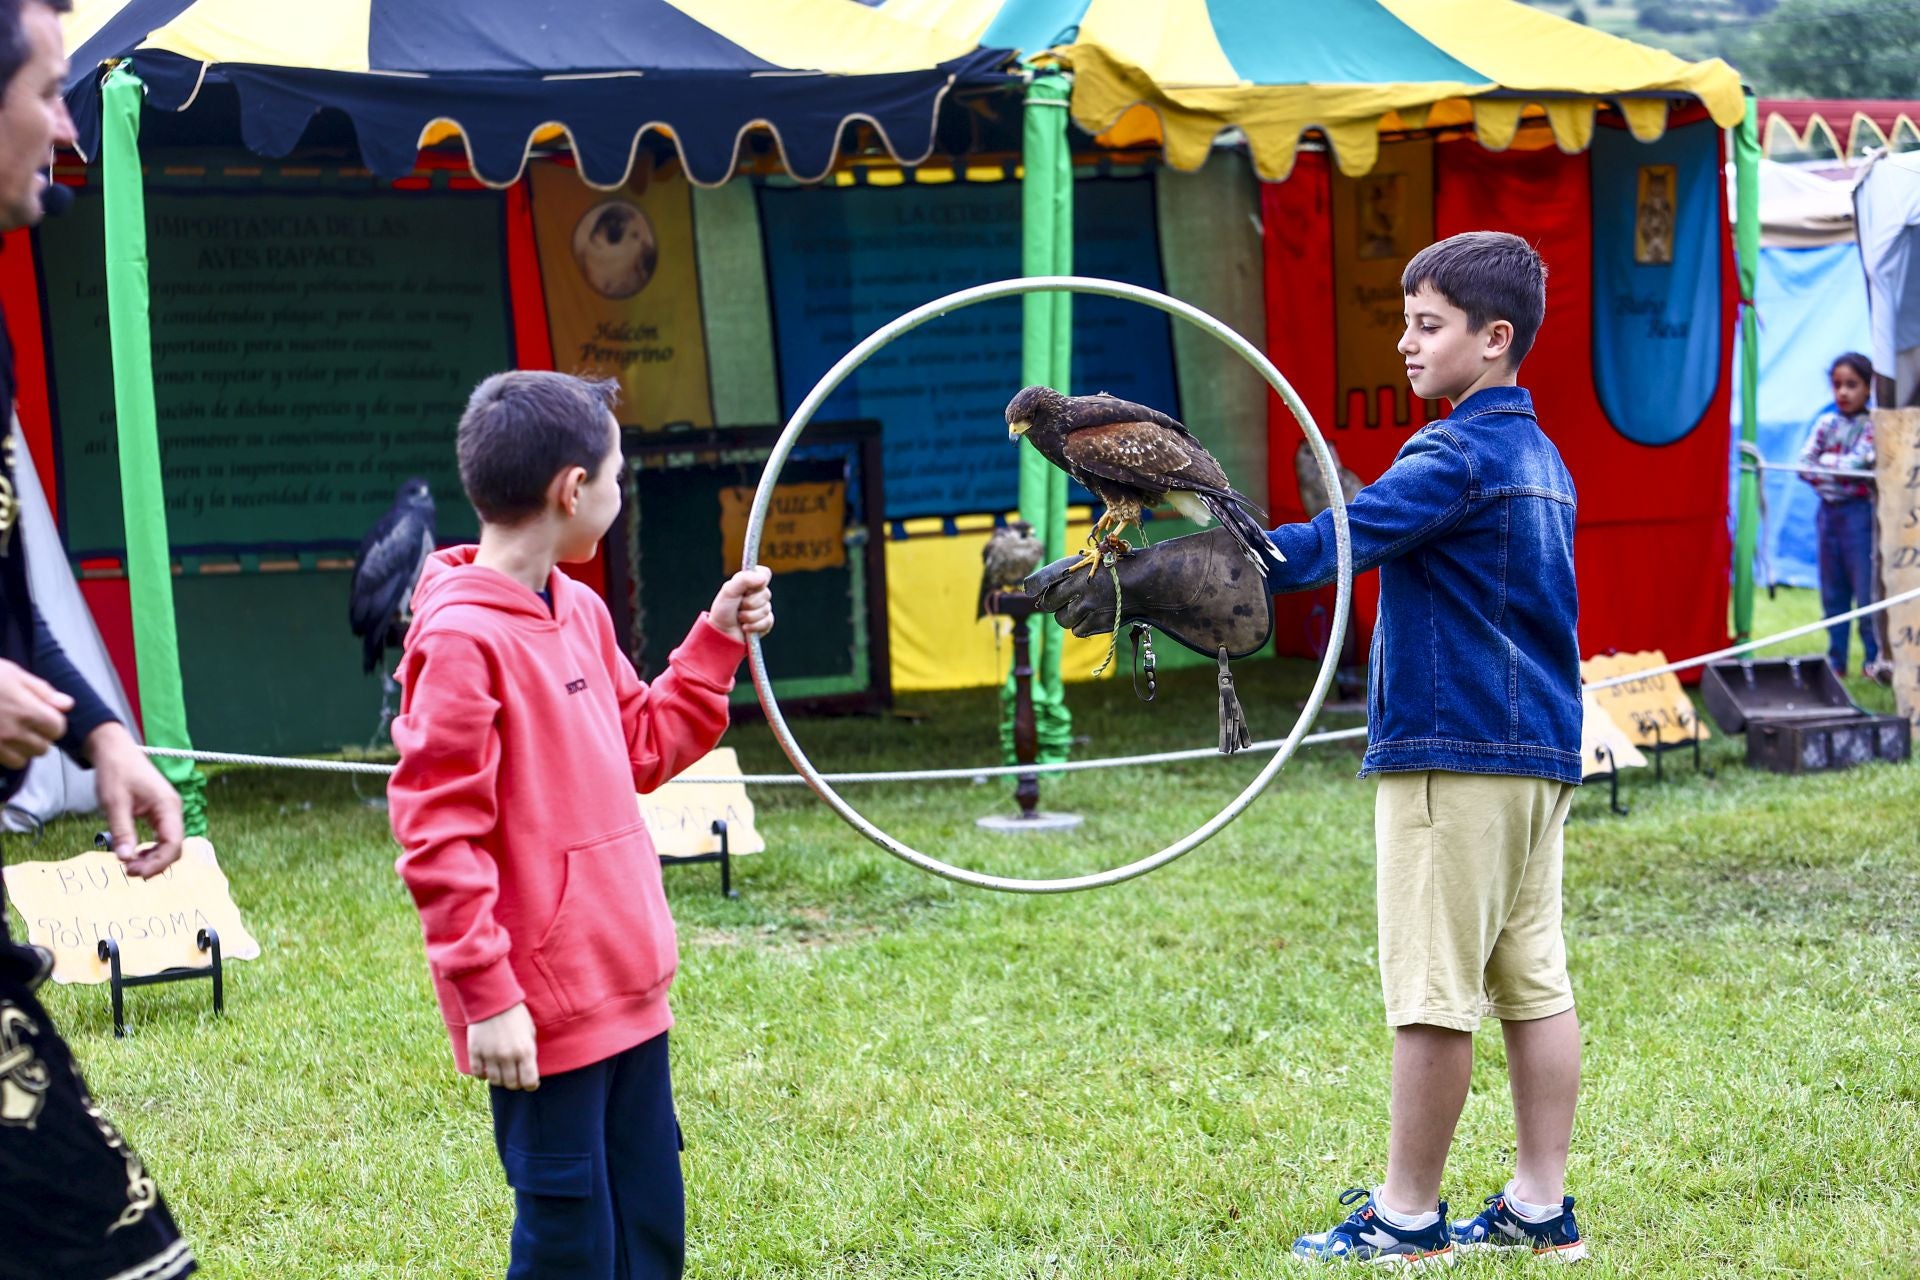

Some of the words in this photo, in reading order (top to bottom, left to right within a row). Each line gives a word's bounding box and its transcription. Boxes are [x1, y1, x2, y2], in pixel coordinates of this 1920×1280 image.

[154, 215, 320, 239] IMPORTANCIA
[197, 246, 259, 269] AVES
[265, 246, 375, 269] RAPACES
